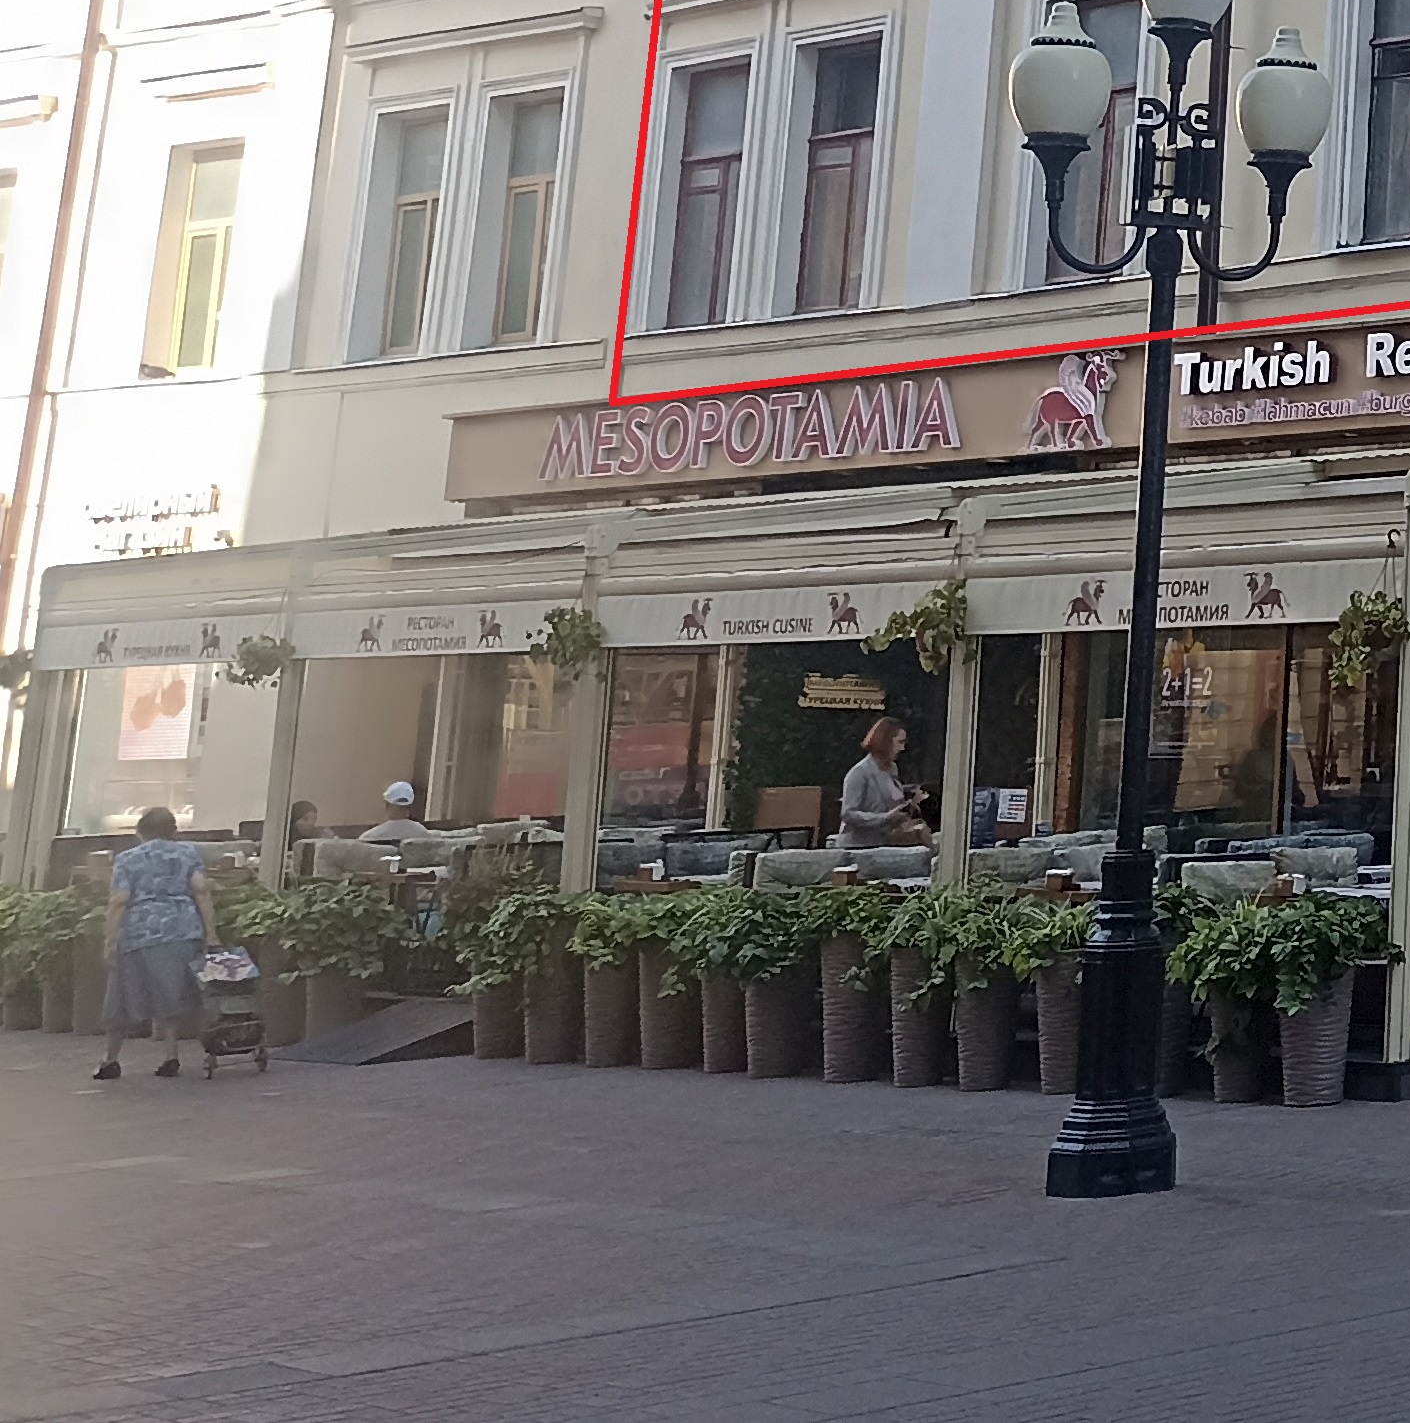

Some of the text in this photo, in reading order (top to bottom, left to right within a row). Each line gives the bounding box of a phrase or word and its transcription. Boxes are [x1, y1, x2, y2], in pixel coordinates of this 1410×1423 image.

[1174, 341, 1331, 395] Turkish
[1181, 400, 1247, 428] #kebab
[1250, 396, 1352, 423] #lahmacun
[538, 377, 960, 481] MESOPOTAMIA
[1157, 580, 1210, 598] СТОРАН
[723, 617, 813, 636] TURKISH CUSINE
[1117, 603, 1229, 625] МПОТАМИЯ
[1161, 666, 1213, 696] 2+1=2
